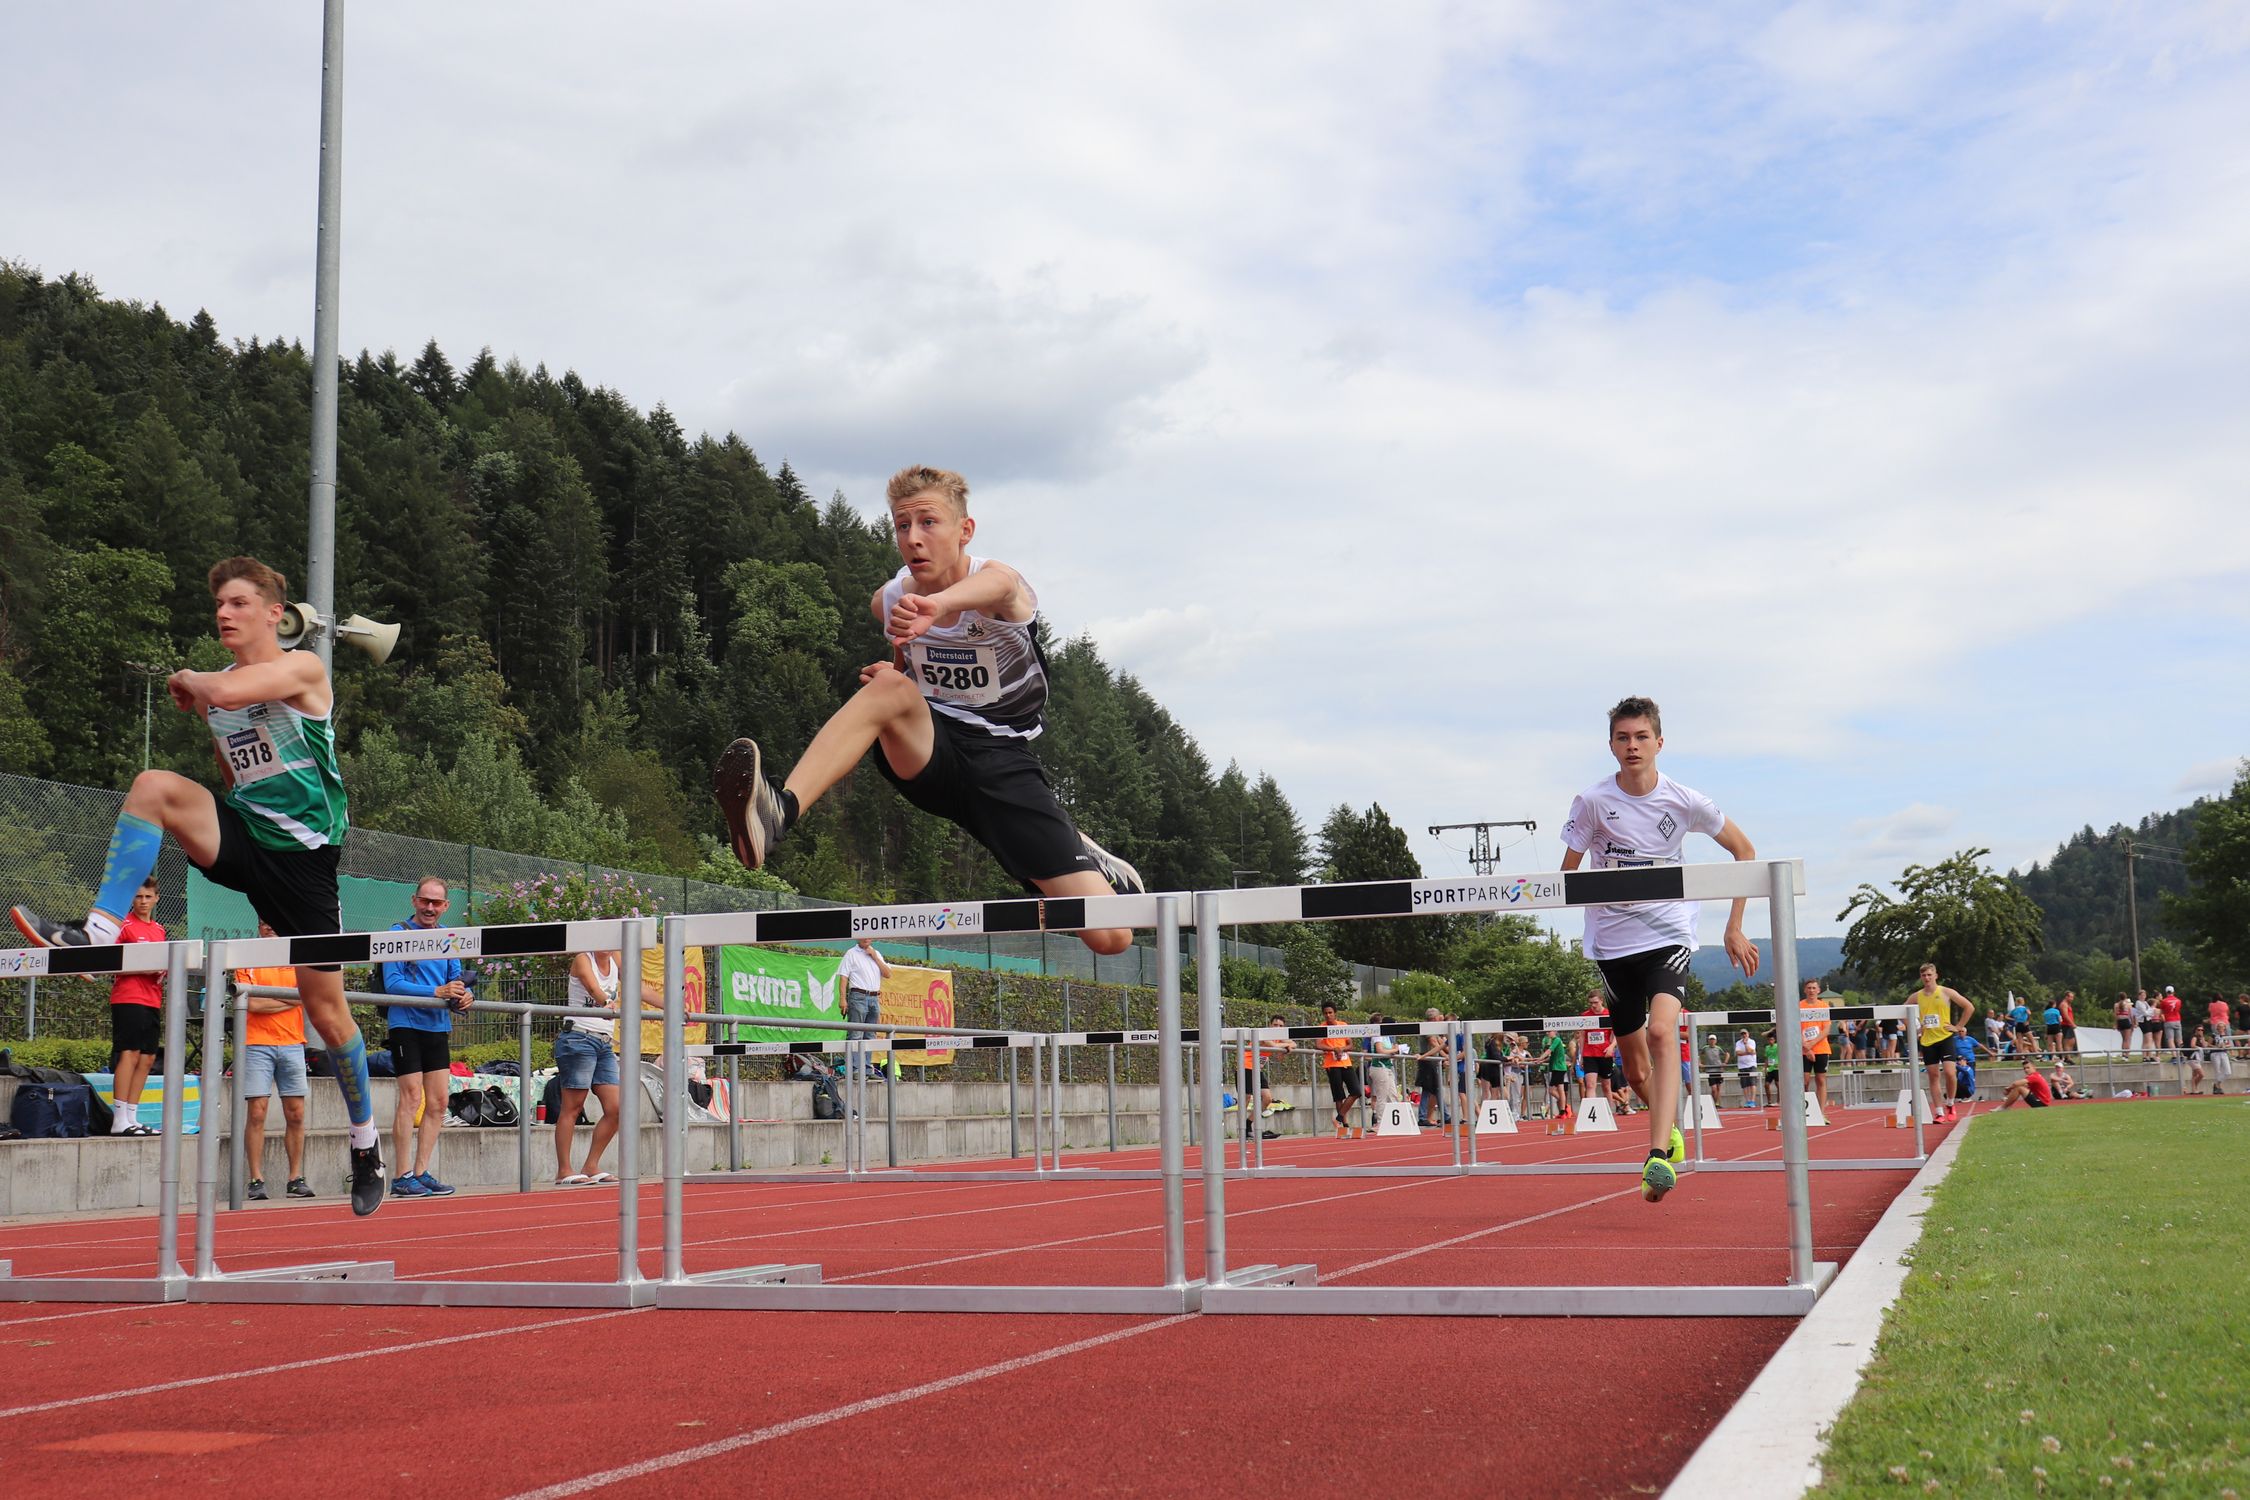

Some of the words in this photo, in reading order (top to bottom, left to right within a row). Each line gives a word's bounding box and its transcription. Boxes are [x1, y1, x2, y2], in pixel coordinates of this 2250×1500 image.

[929, 648, 973, 661] Peterstaler
[921, 664, 989, 690] 5280
[229, 742, 272, 771] 5318
[1413, 885, 1511, 905] SPORTPARK
[1534, 883, 1561, 898] Zell
[853, 914, 937, 931] SPORTPARK
[957, 912, 980, 926] Zell
[372, 939, 442, 955] SPORTPARK
[460, 937, 480, 950] Zell
[29, 956, 47, 968] Zell
[731, 967, 801, 1008] erima
[1391, 1109, 1400, 1126] 6
[1489, 1108, 1498, 1125] 5
[1588, 1106, 1597, 1123] 4
